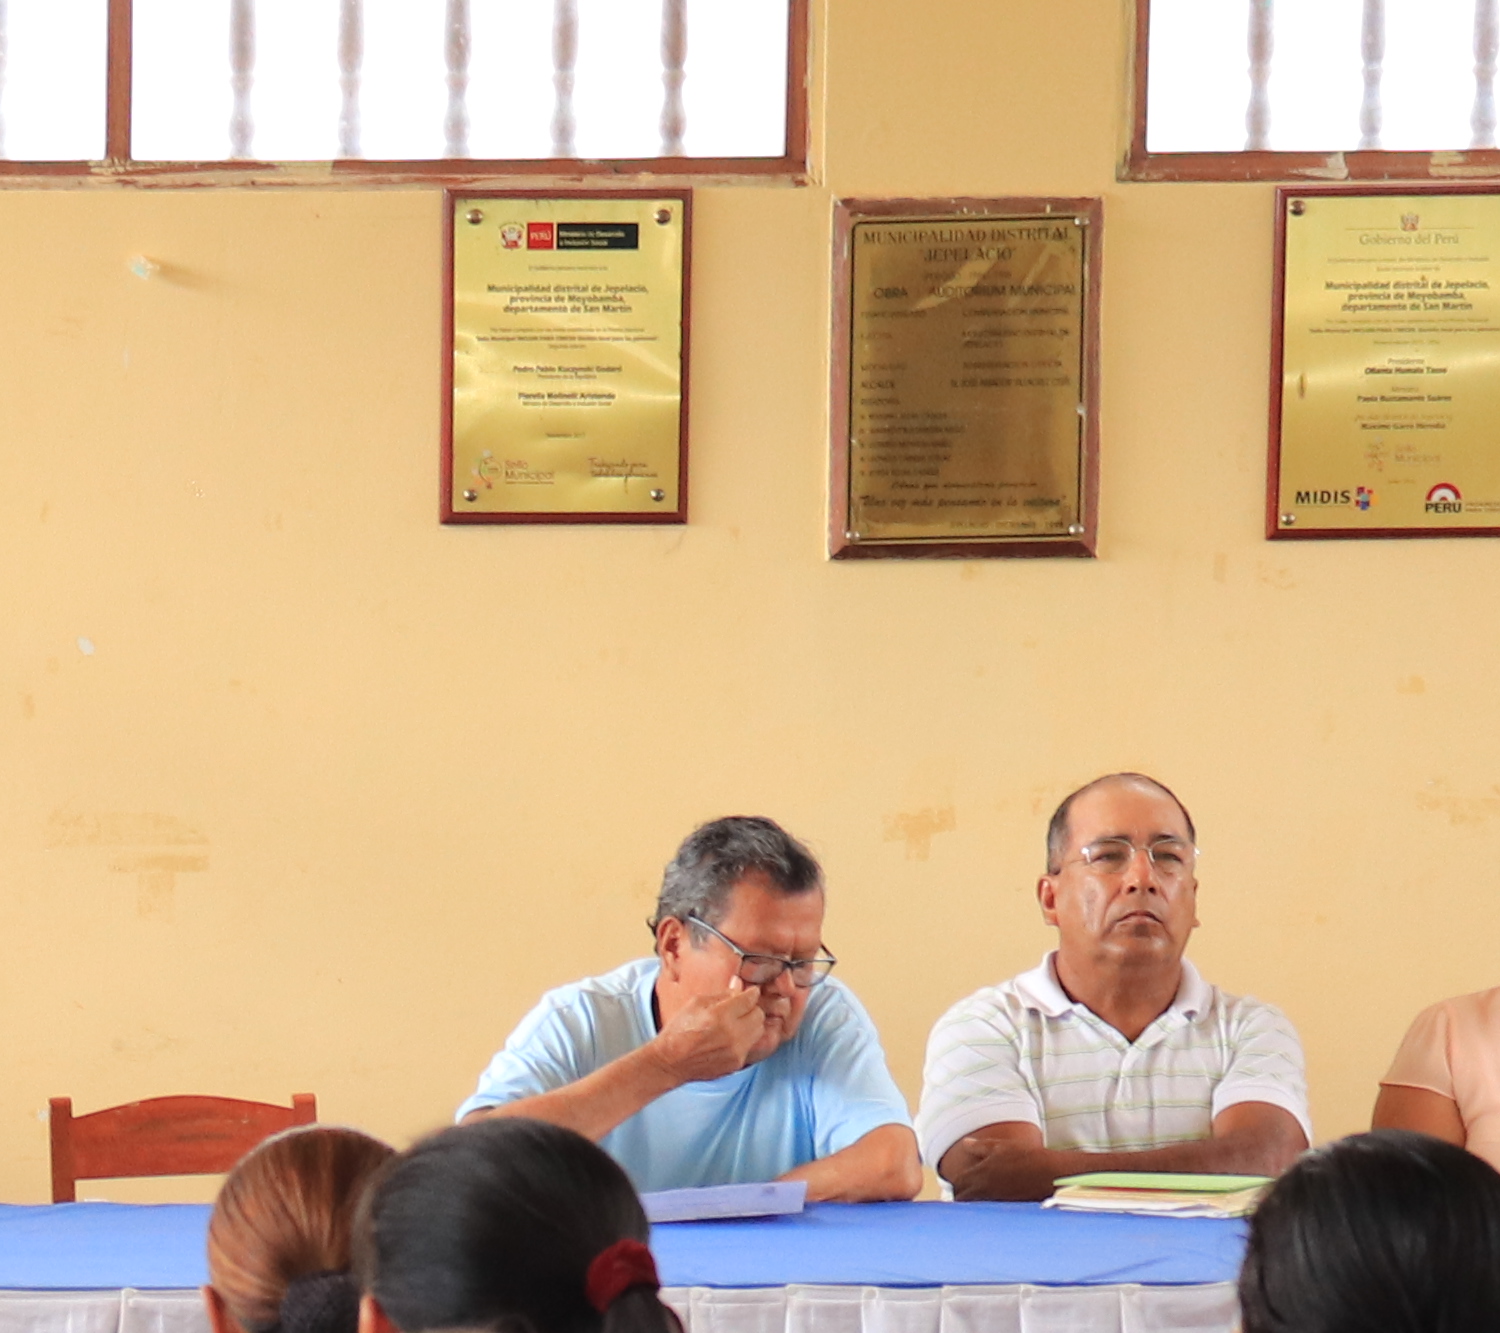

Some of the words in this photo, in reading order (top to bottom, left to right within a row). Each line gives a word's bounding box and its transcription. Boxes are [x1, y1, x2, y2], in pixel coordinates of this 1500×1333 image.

[863, 229, 987, 244] MUNICIPALIDAD
[991, 227, 1072, 242] DISTRITAL
[1359, 233, 1412, 246] Gobierno
[1414, 233, 1431, 245] del
[1434, 232, 1460, 245] Perú
[487, 284, 552, 295] Municipalidad
[553, 284, 590, 294] distrital
[591, 284, 602, 294] de
[1325, 281, 1391, 291] Municipalidad
[1392, 280, 1429, 290] distrital
[1431, 280, 1442, 290] de
[509, 294, 553, 305] provincia
[554, 294, 566, 304] de
[1348, 291, 1391, 302] provincia
[1393, 291, 1405, 301] de
[503, 304, 568, 315] departamento
[570, 304, 582, 314] de
[583, 304, 601, 314] San
[1341, 302, 1407, 313] departamento
[1409, 302, 1421, 312] de
[1423, 301, 1440, 312] San
[1295, 490, 1351, 504] MIDIS
